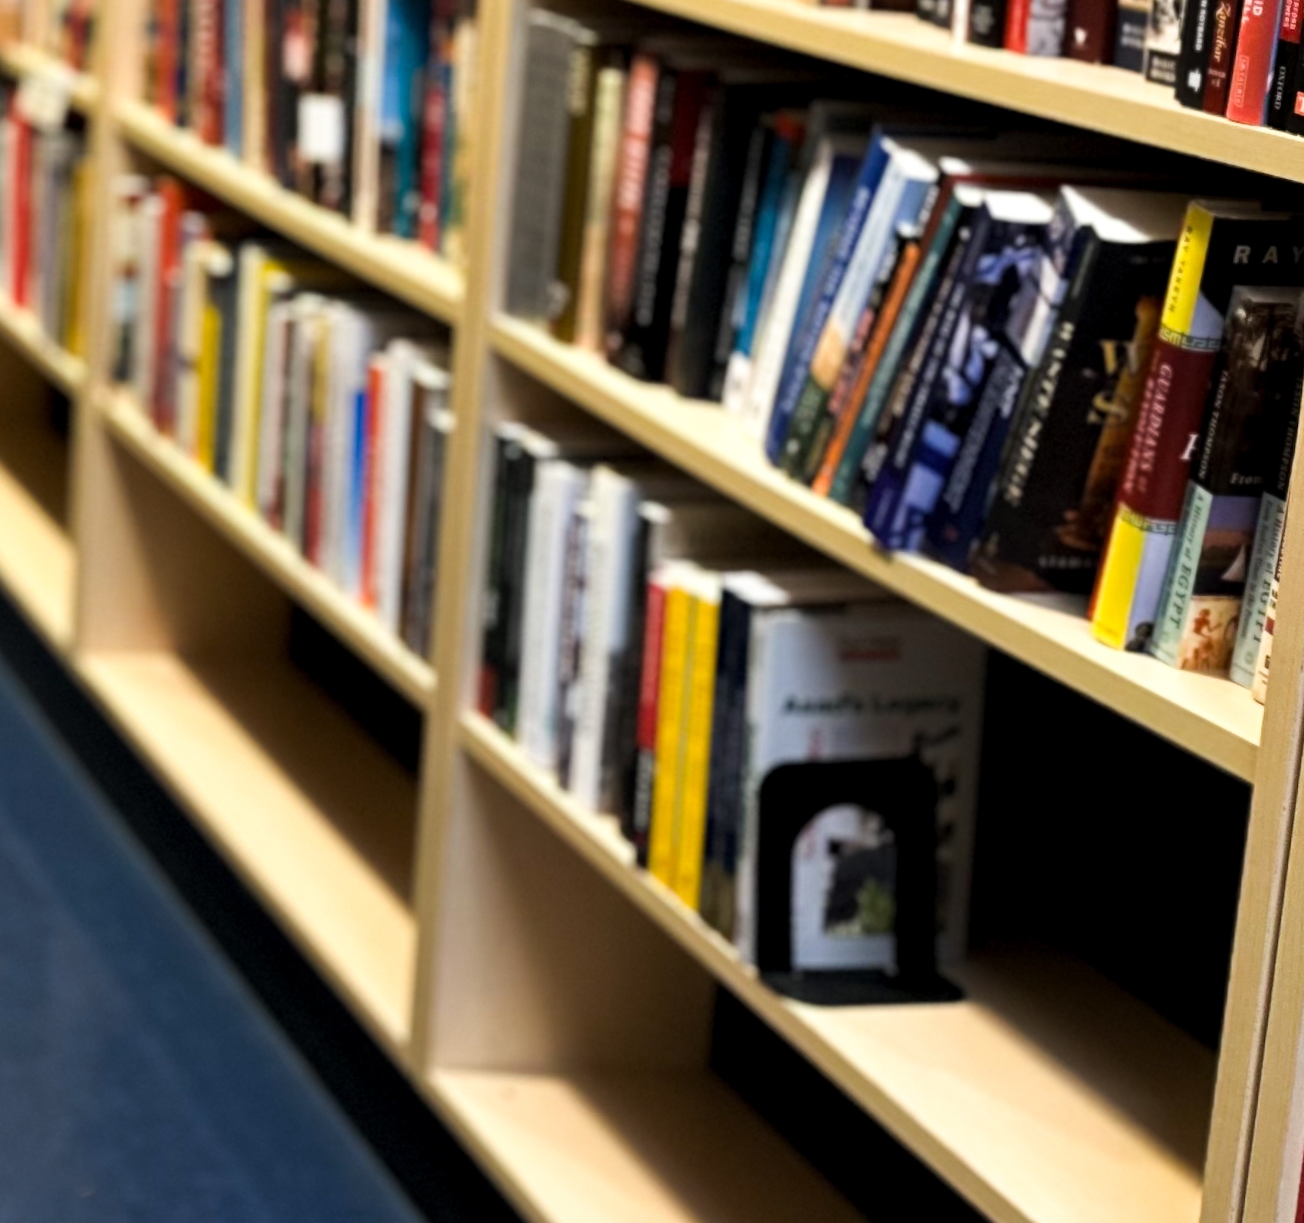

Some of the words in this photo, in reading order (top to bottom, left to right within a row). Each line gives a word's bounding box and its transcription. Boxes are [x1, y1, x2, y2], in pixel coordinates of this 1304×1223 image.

[1194, 8, 1207, 52] ROTBARD
[1213, 2, 1234, 63] Zanzibar
[1274, 65, 1287, 111] OXFORD
[1182, 225, 1194, 254] RAY
[1166, 260, 1187, 314] TAKEYH
[1214, 369, 1230, 408] JASON
[1140, 362, 1174, 472] GUARDIANS
[1198, 410, 1220, 480] THOMPSON
[1184, 505, 1202, 545] History
[1268, 516, 1283, 561] History
[1169, 564, 1192, 629] EGYPT
